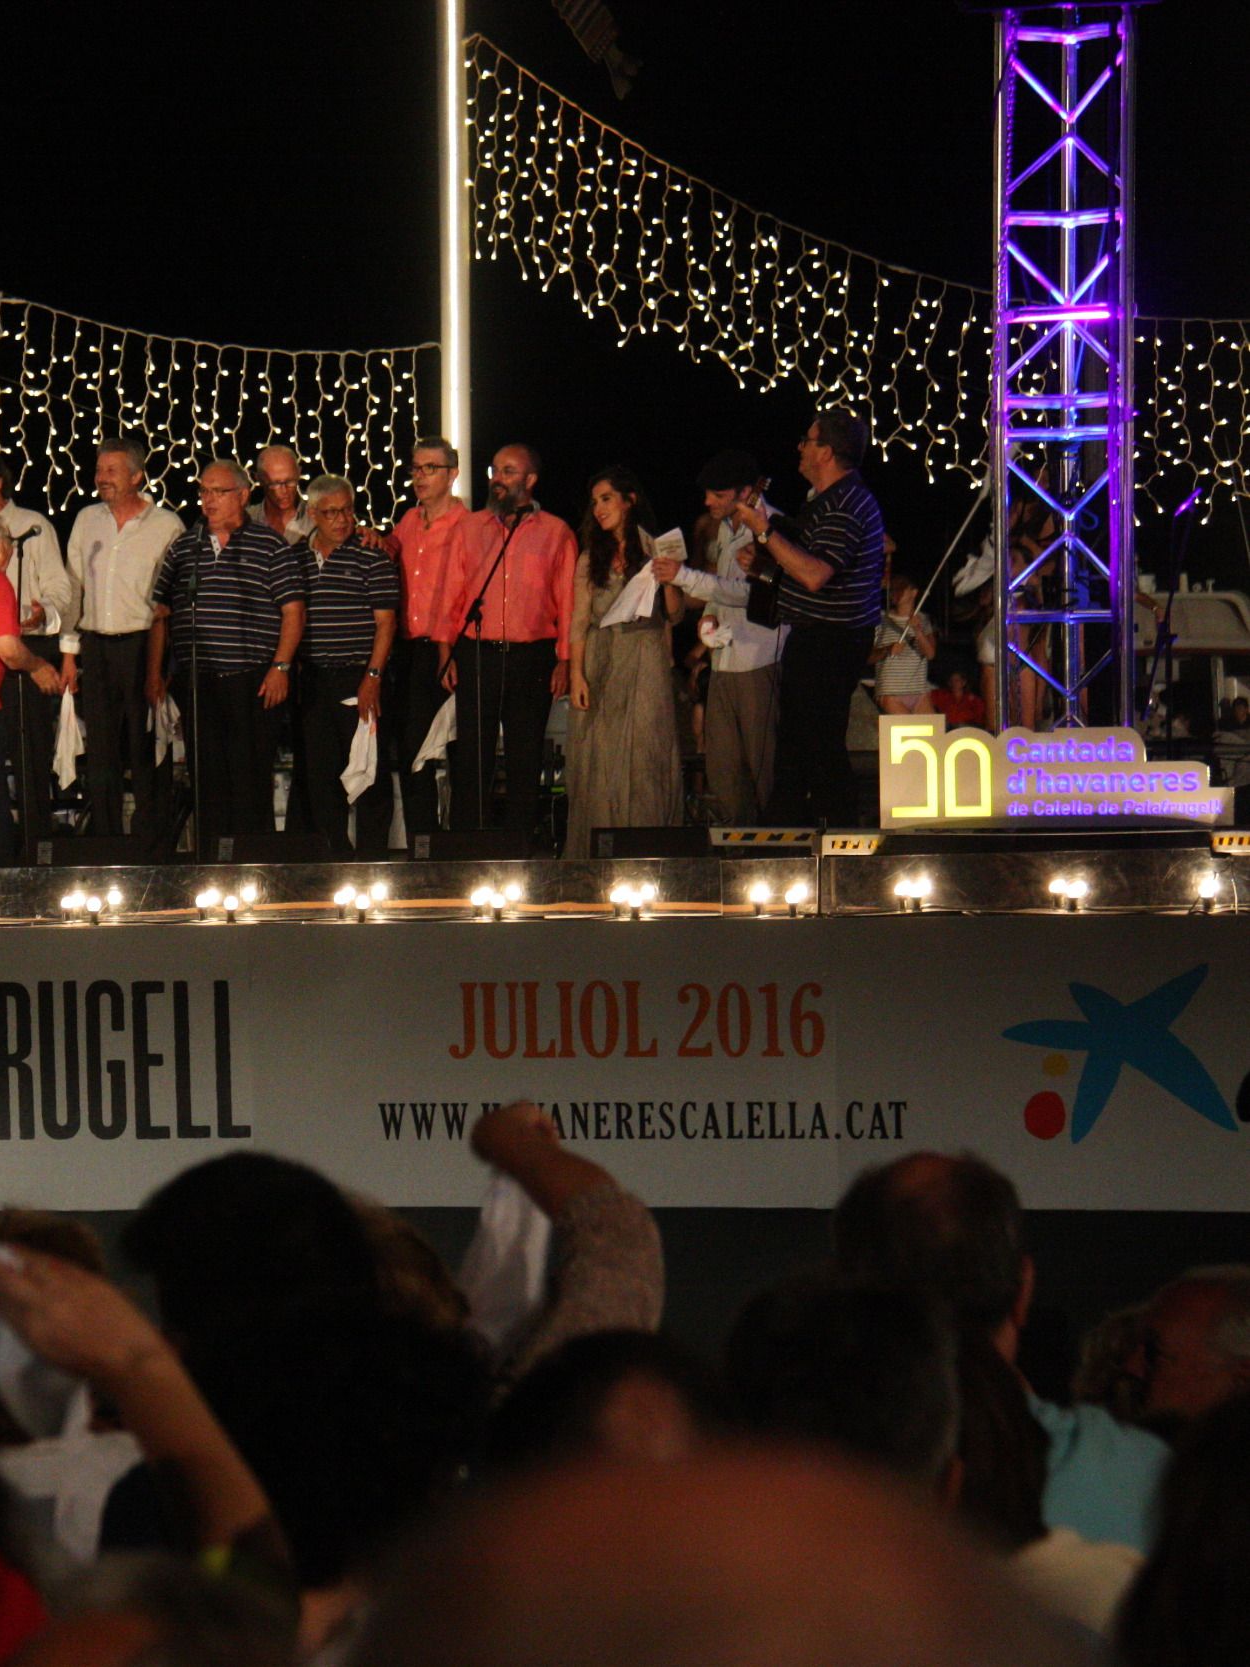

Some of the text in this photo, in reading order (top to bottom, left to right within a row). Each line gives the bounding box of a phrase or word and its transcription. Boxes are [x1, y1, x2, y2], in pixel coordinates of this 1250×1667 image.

[1006, 736, 1135, 764] Cantada
[890, 725, 992, 818] 50
[1006, 768, 1201, 795] d'havaneres
[1006, 798, 1225, 819] de Calella de Palafrugell
[449, 980, 826, 1060] JULIOL 2016
